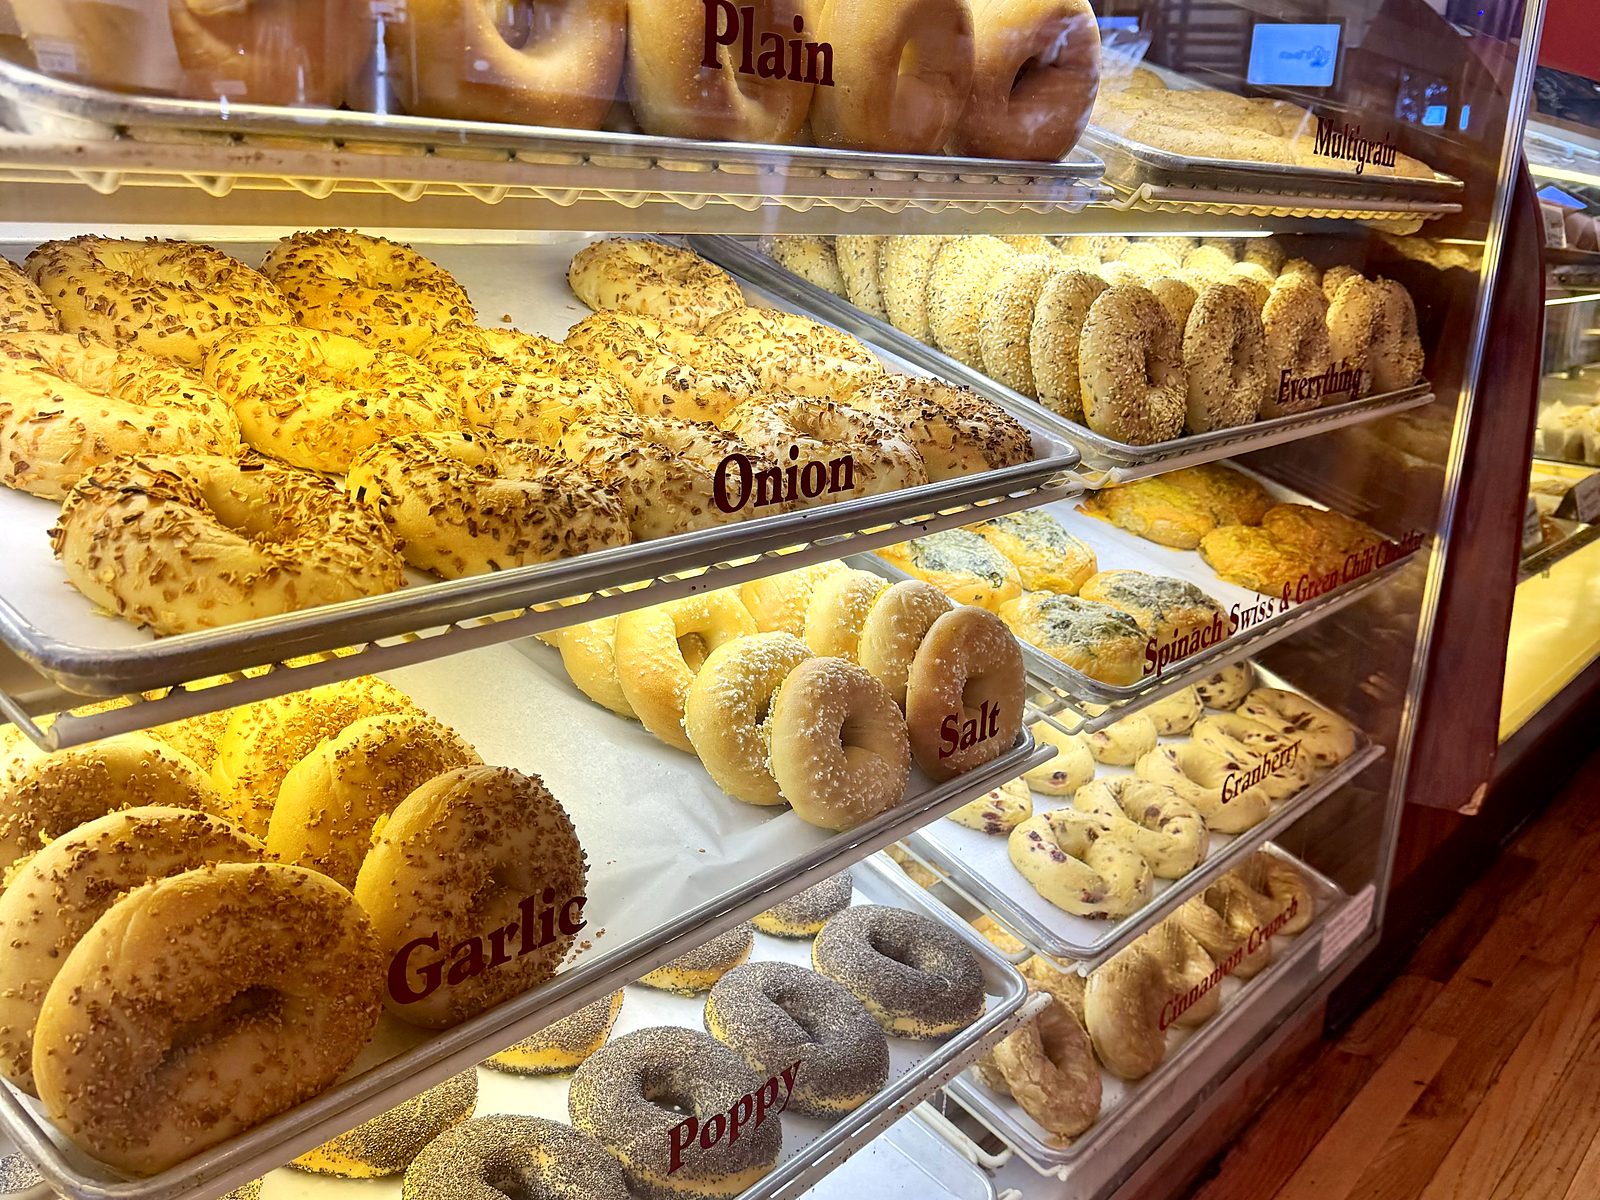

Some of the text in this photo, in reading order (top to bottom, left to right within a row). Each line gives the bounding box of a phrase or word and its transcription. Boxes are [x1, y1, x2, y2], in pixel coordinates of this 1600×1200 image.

[701, 0, 835, 87] Plain
[1313, 117, 1397, 175] Multigrain
[1277, 357, 1362, 405] Everything
[713, 444, 854, 513] Onion
[1142, 611, 1223, 678] Spinach
[1228, 594, 1274, 636] Swiss
[1279, 581, 1292, 613] &
[1295, 570, 1339, 605] Green
[1342, 545, 1375, 583] Chili
[939, 700, 1000, 760] Salt
[1221, 740, 1302, 804] Cranberry
[387, 887, 588, 1005] Garlic
[1158, 947, 1242, 1032] Cinnamon
[1247, 896, 1299, 954] Crunch
[667, 1060, 801, 1176] Poppy
